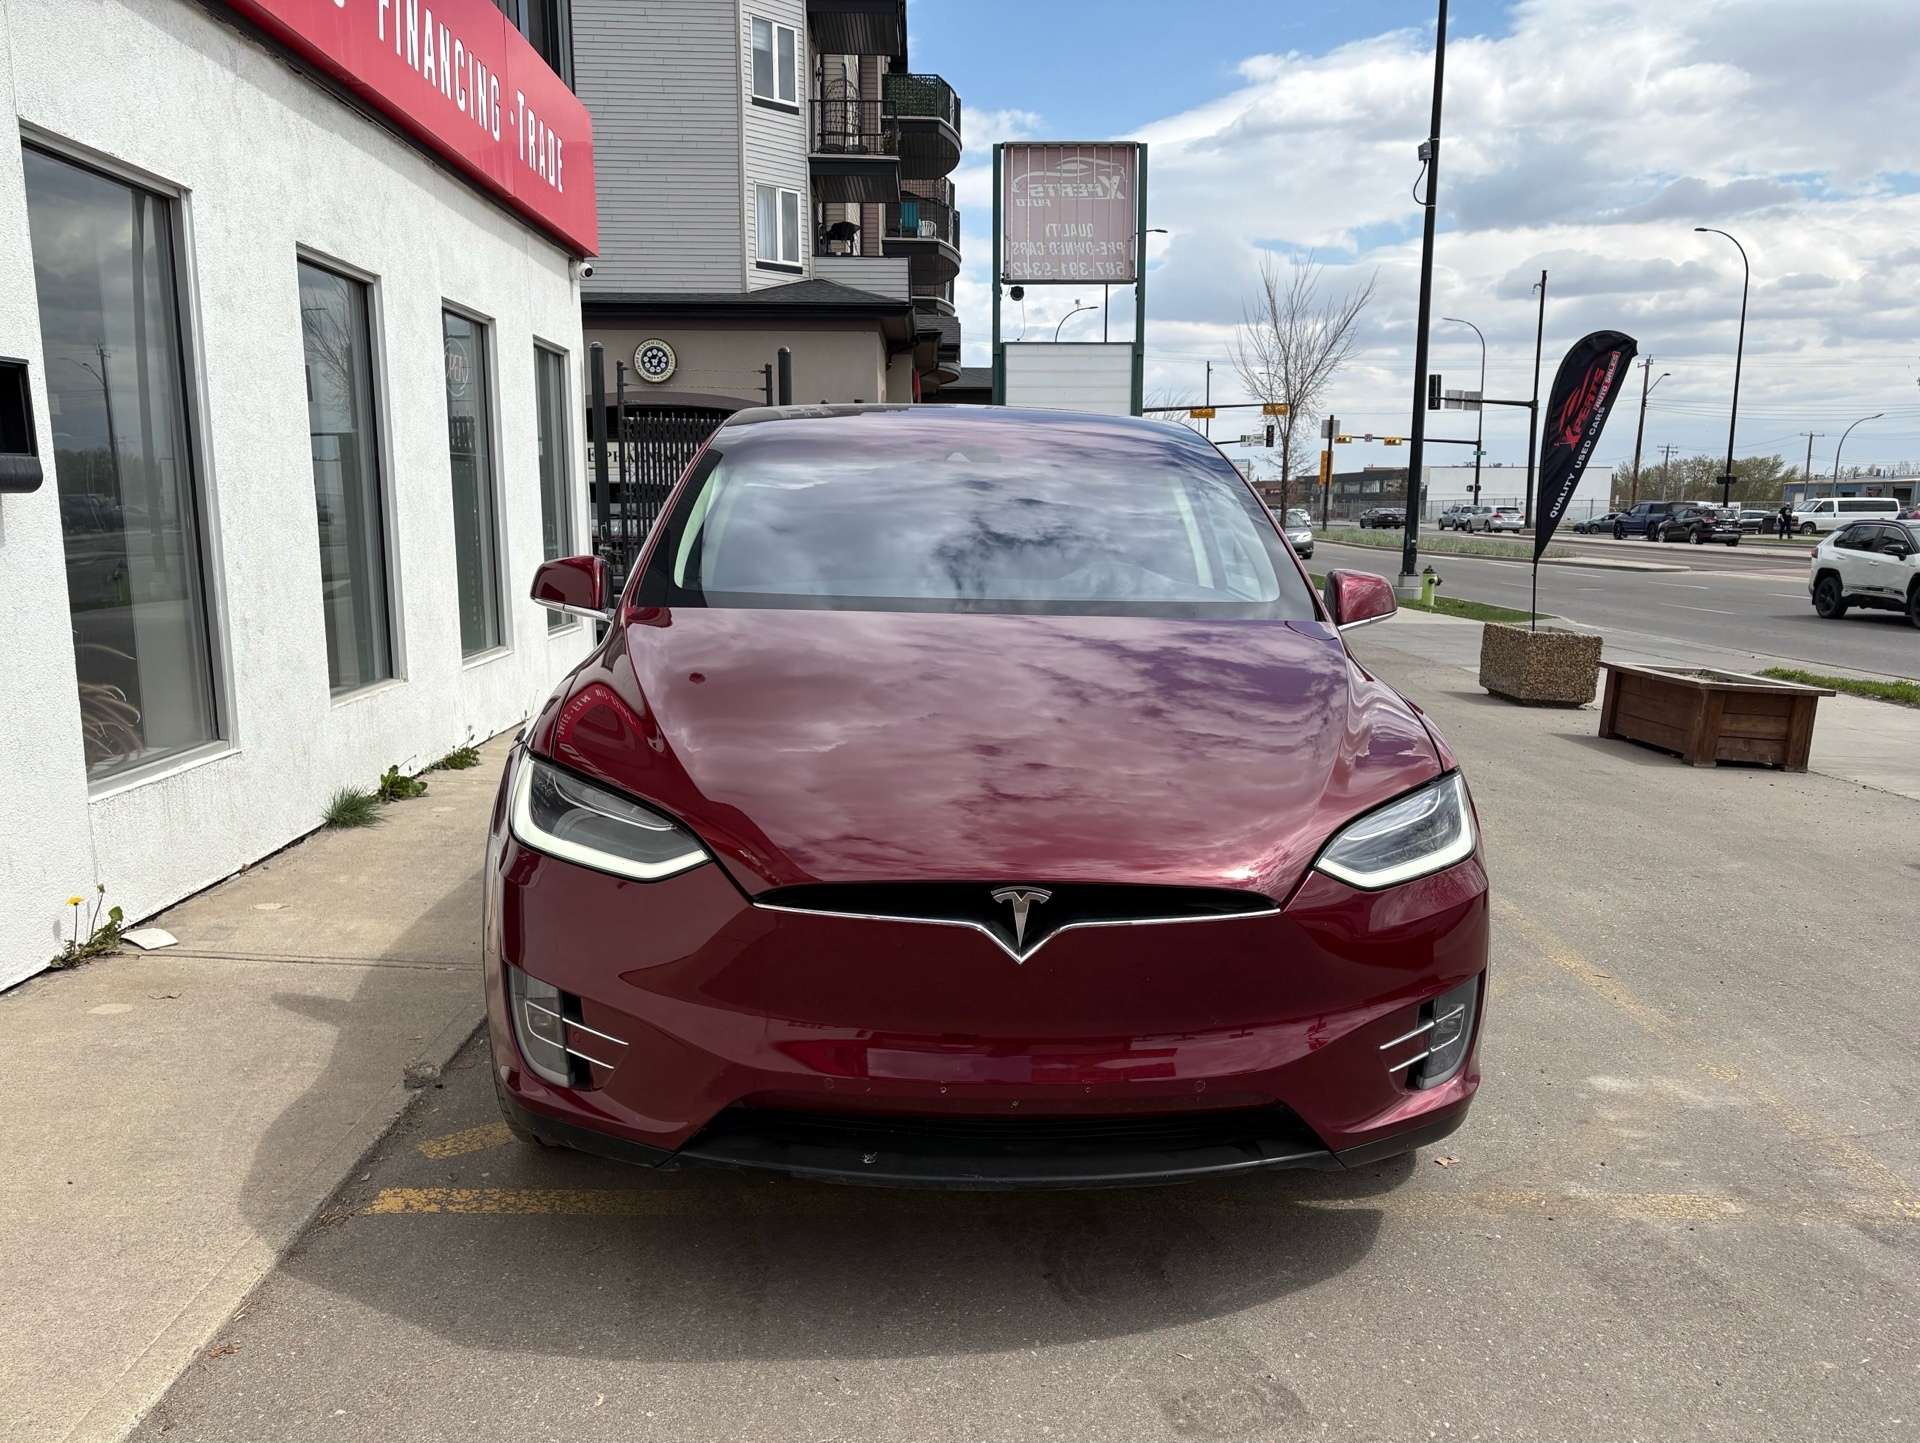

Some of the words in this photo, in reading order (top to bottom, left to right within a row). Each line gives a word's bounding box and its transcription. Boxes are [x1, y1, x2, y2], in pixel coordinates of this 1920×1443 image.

[517, 90, 564, 193] TRADE
[1550, 472, 1575, 518] QUALITY
[1575, 440, 1592, 469] USED
[1588, 406, 1605, 436] CARS
